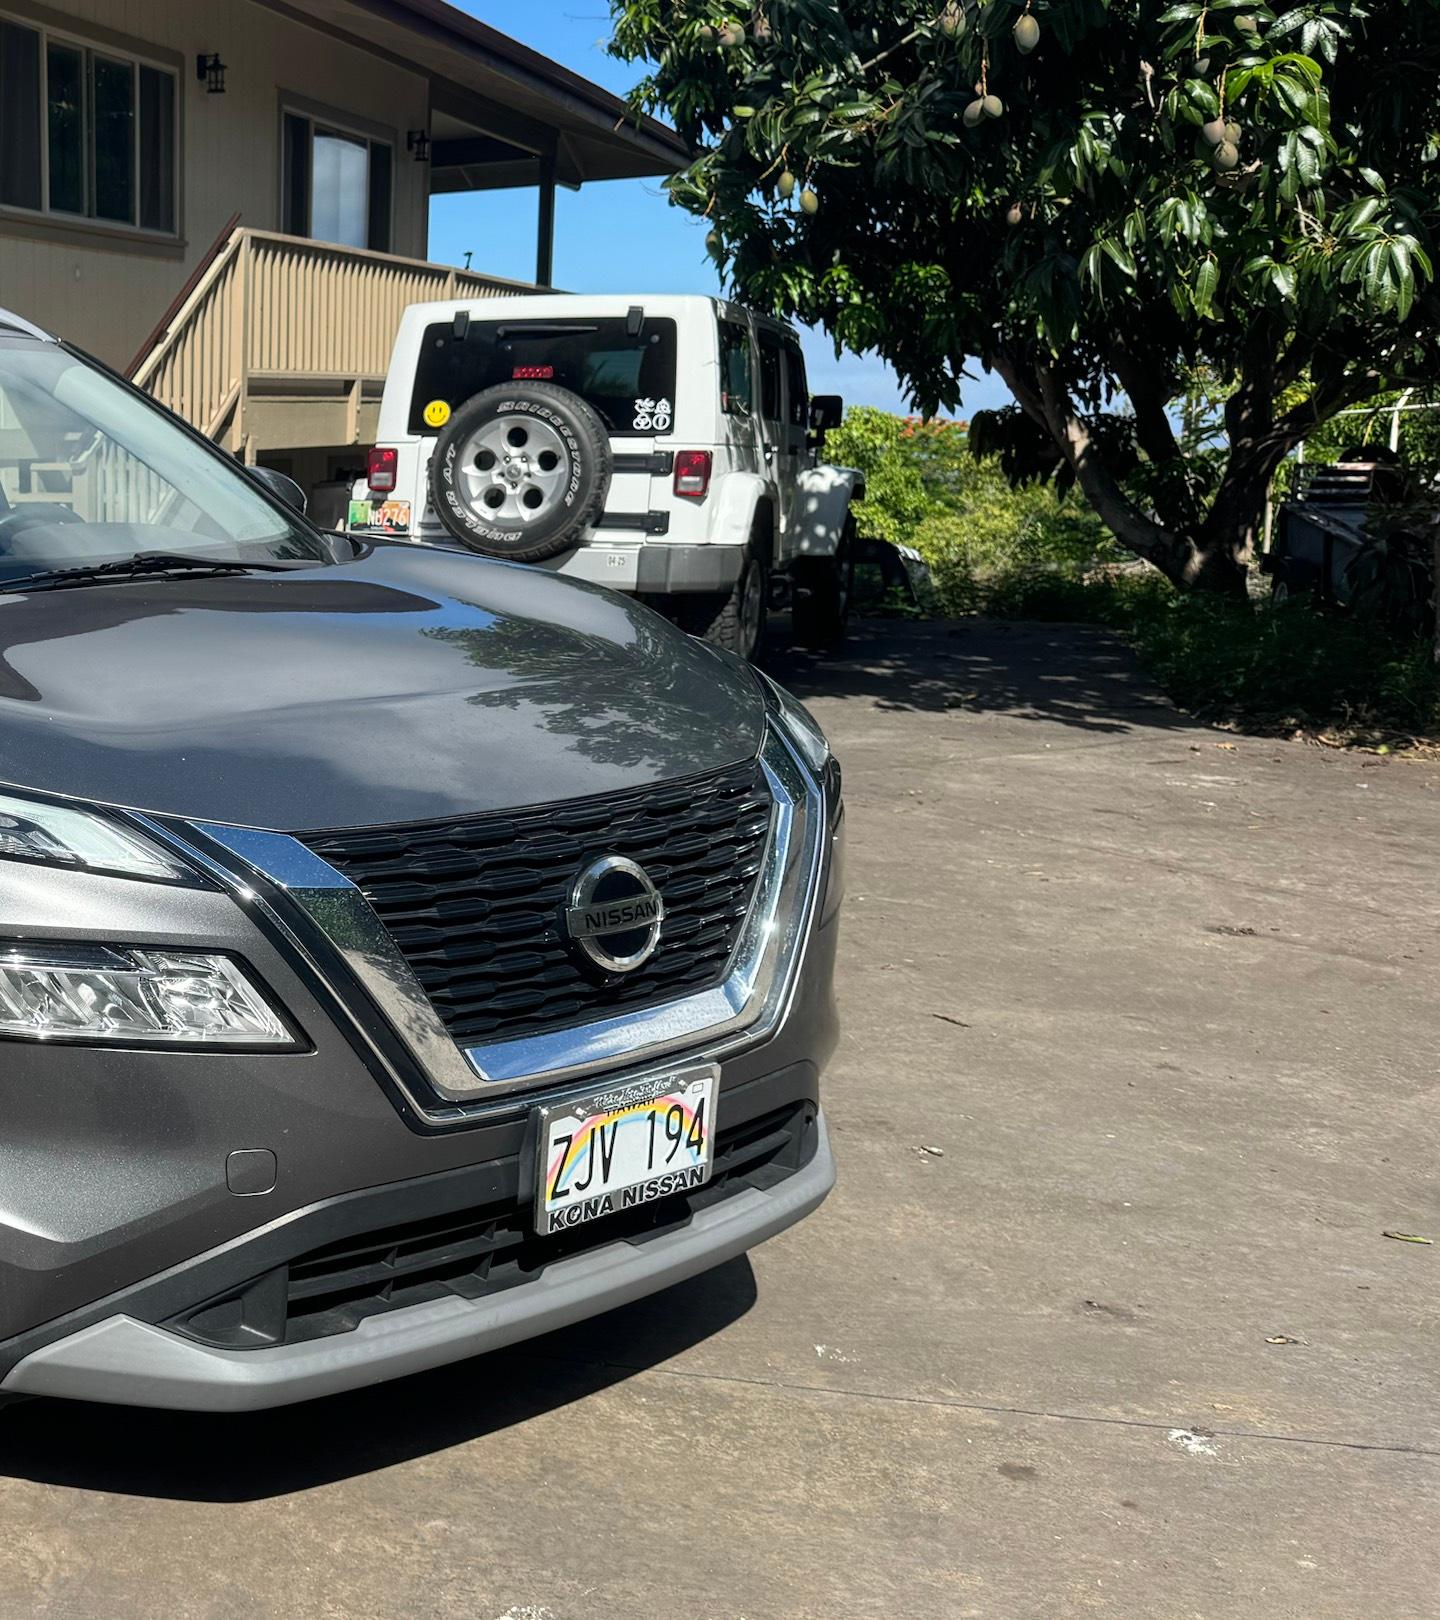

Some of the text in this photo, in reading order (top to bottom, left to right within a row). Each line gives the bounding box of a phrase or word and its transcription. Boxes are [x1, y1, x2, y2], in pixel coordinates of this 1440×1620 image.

[443, 443, 523, 542] DUELER A/T
[497, 401, 582, 507] BRIDGESTONE
[585, 901, 657, 930] NISSAN
[551, 1098, 706, 1200] ZJV 194
[547, 1165, 705, 1233] KONA NISSAN
